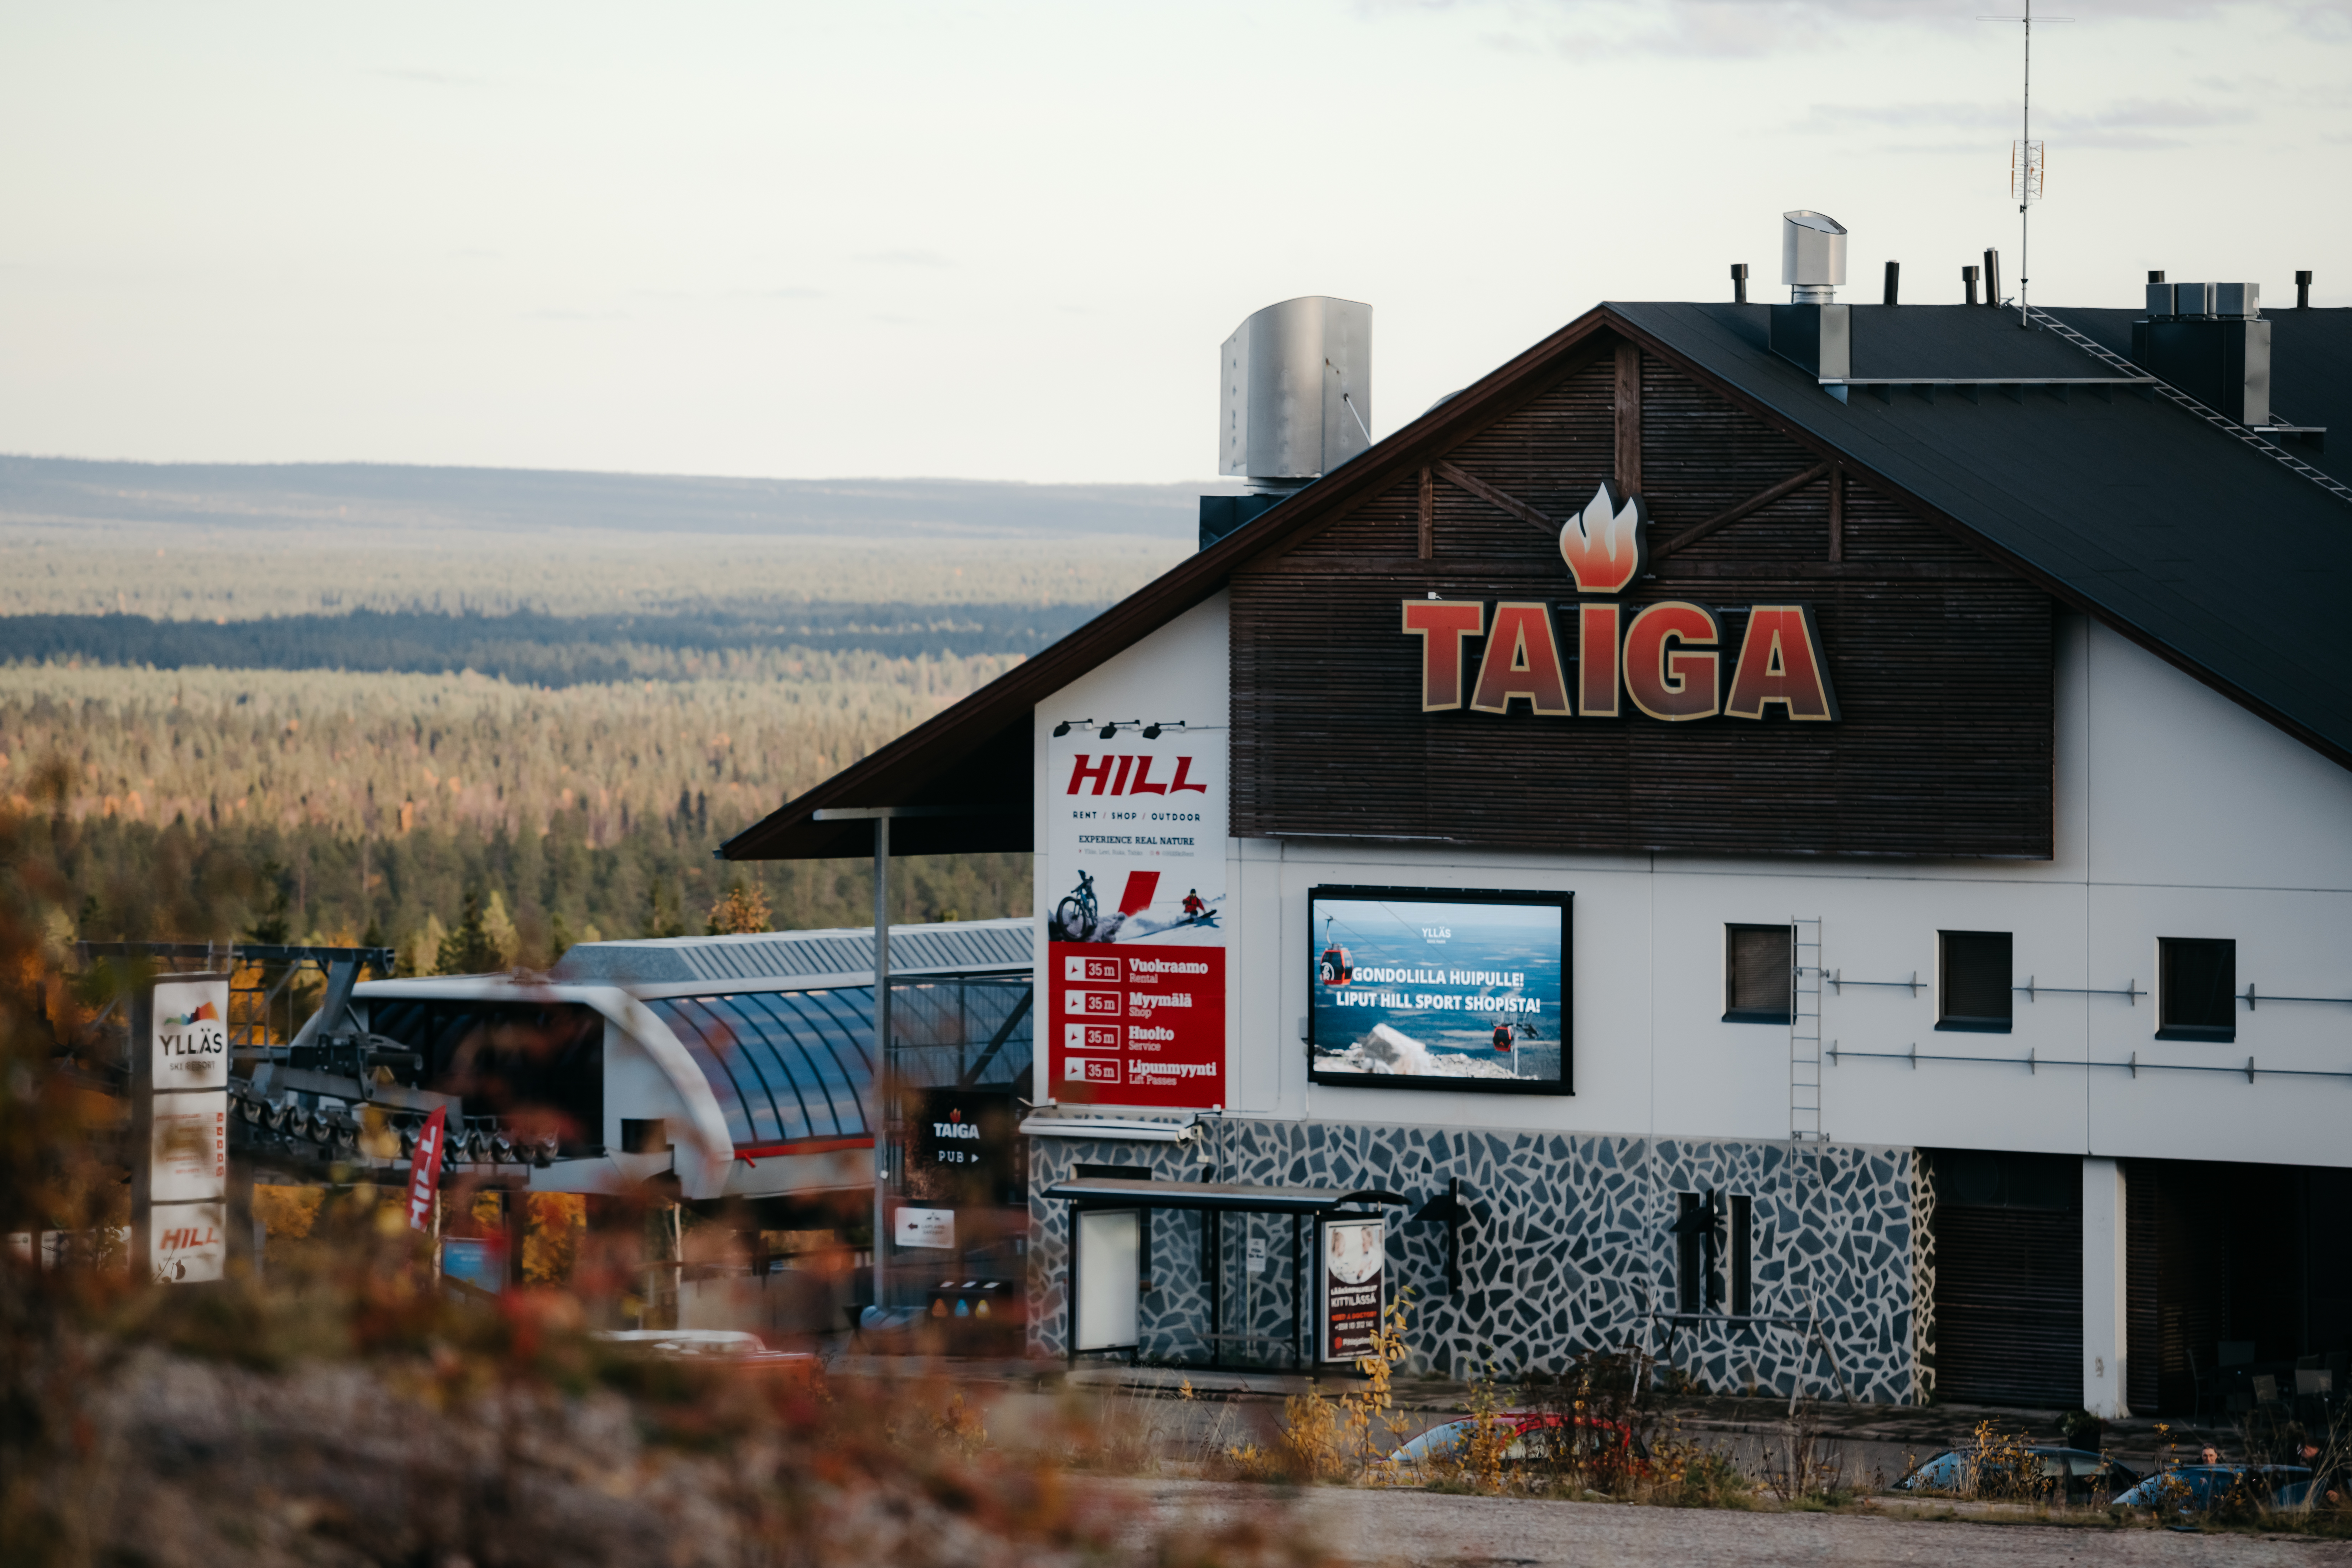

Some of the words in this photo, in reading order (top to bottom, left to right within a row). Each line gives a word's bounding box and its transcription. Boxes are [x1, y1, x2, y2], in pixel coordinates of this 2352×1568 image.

[1402, 600, 1833, 721] TAIGA
[1067, 754, 1207, 796] HILL
[1151, 813, 1200, 822] OUTDOOR
[1079, 835, 1132, 844] EXPERIENCE
[1160, 837, 1194, 845] NATURE
[1422, 926, 1451, 938] YLLÄS
[1088, 963, 1102, 976] 35
[1103, 966, 1115, 977] m
[1129, 958, 1208, 974] Vuokraamo
[1129, 973, 1158, 984] Rental
[1352, 966, 1447, 985] GONDOLILLA
[1449, 970, 1524, 988] HUIPULLE!
[1088, 997, 1102, 1010] 35
[1103, 999, 1115, 1010] m
[1129, 992, 1192, 1008] Myymälä
[1336, 991, 1377, 1007] LIPUT
[1380, 993, 1412, 1009] HILL
[1415, 994, 1462, 1010] SPORT
[1464, 995, 1541, 1013] SHOPISTA!
[1129, 1007, 1152, 1019] Shop
[1088, 1030, 1102, 1043] 35
[1103, 1033, 1115, 1044] m
[1128, 1025, 1175, 1041] Huolto
[159, 1028, 222, 1056] YLLÄS
[1128, 1040, 1161, 1051] Service
[1088, 1064, 1102, 1077] 35
[1103, 1067, 1115, 1078] m
[1128, 1059, 1216, 1078] Lipunmyynti
[1129, 1075, 1144, 1085] Lift
[1146, 1075, 1177, 1086] Passes
[934, 1123, 980, 1139] TAIGA
[938, 1151, 964, 1163] PUB
[160, 1227, 219, 1250] HILL
[1331, 1292, 1376, 1307] KITTILÄSSÄ
